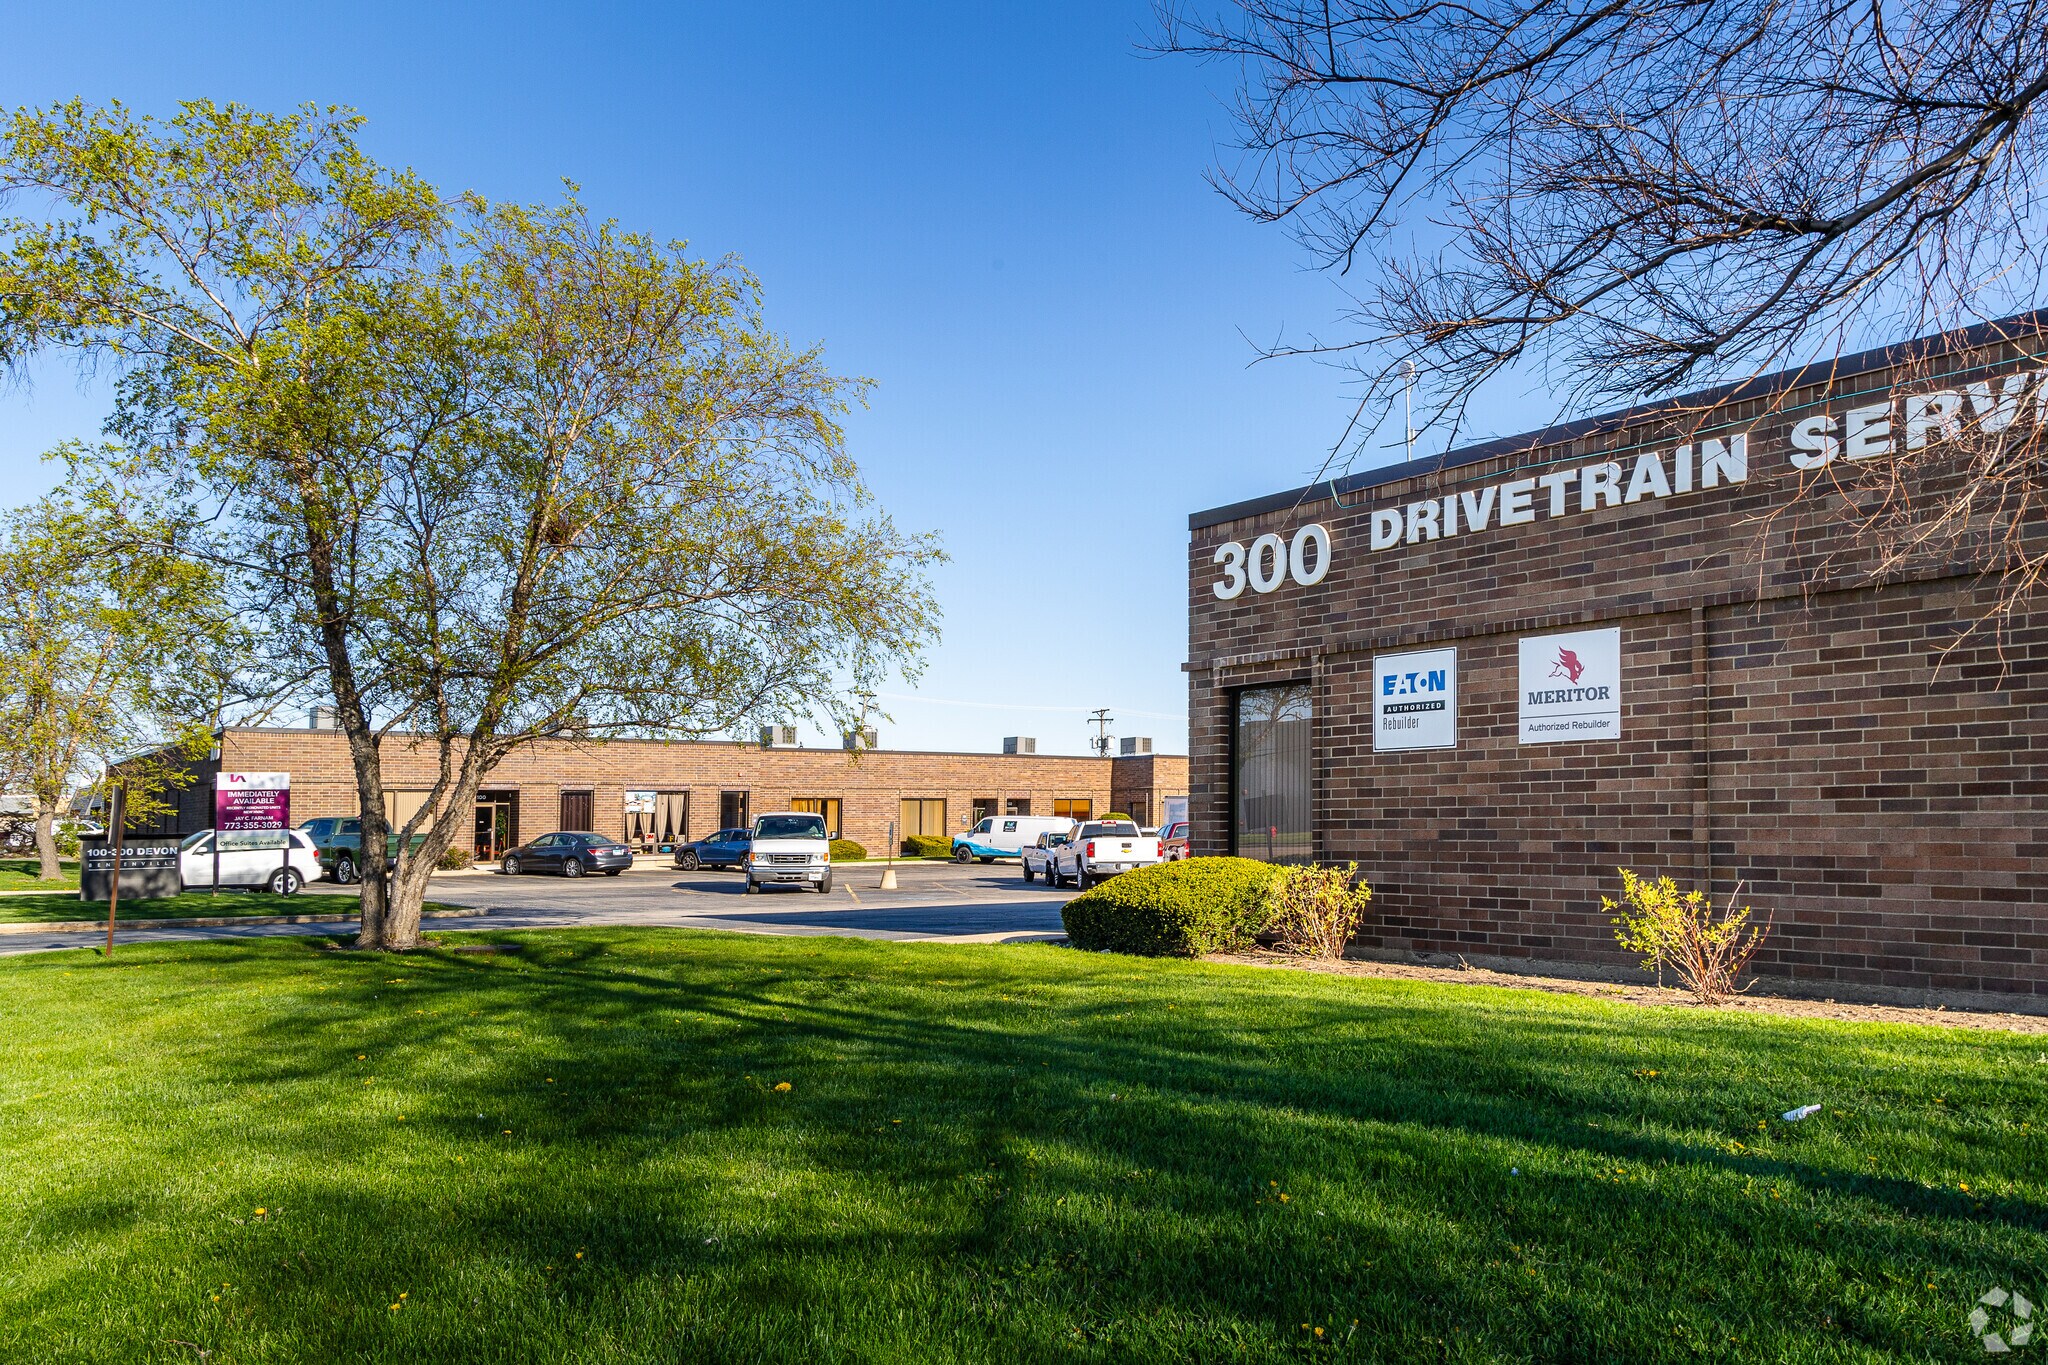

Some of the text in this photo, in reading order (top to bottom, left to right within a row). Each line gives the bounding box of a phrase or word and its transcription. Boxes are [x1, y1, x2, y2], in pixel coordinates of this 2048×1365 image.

[1211, 522, 1333, 601] 300
[1369, 432, 1749, 552] DRIVETRAIN
[1383, 669, 1446, 696] EATON
[1527, 686, 1610, 705] MERITOR
[1386, 701, 1442, 713] AUTHORIZED
[1383, 716, 1420, 730] Rebuilder
[1528, 719, 1610, 732] Authorized Rebuilder
[224, 821, 283, 829] 773-355-3029
[87, 847, 178, 857] 100-300 DEVON
